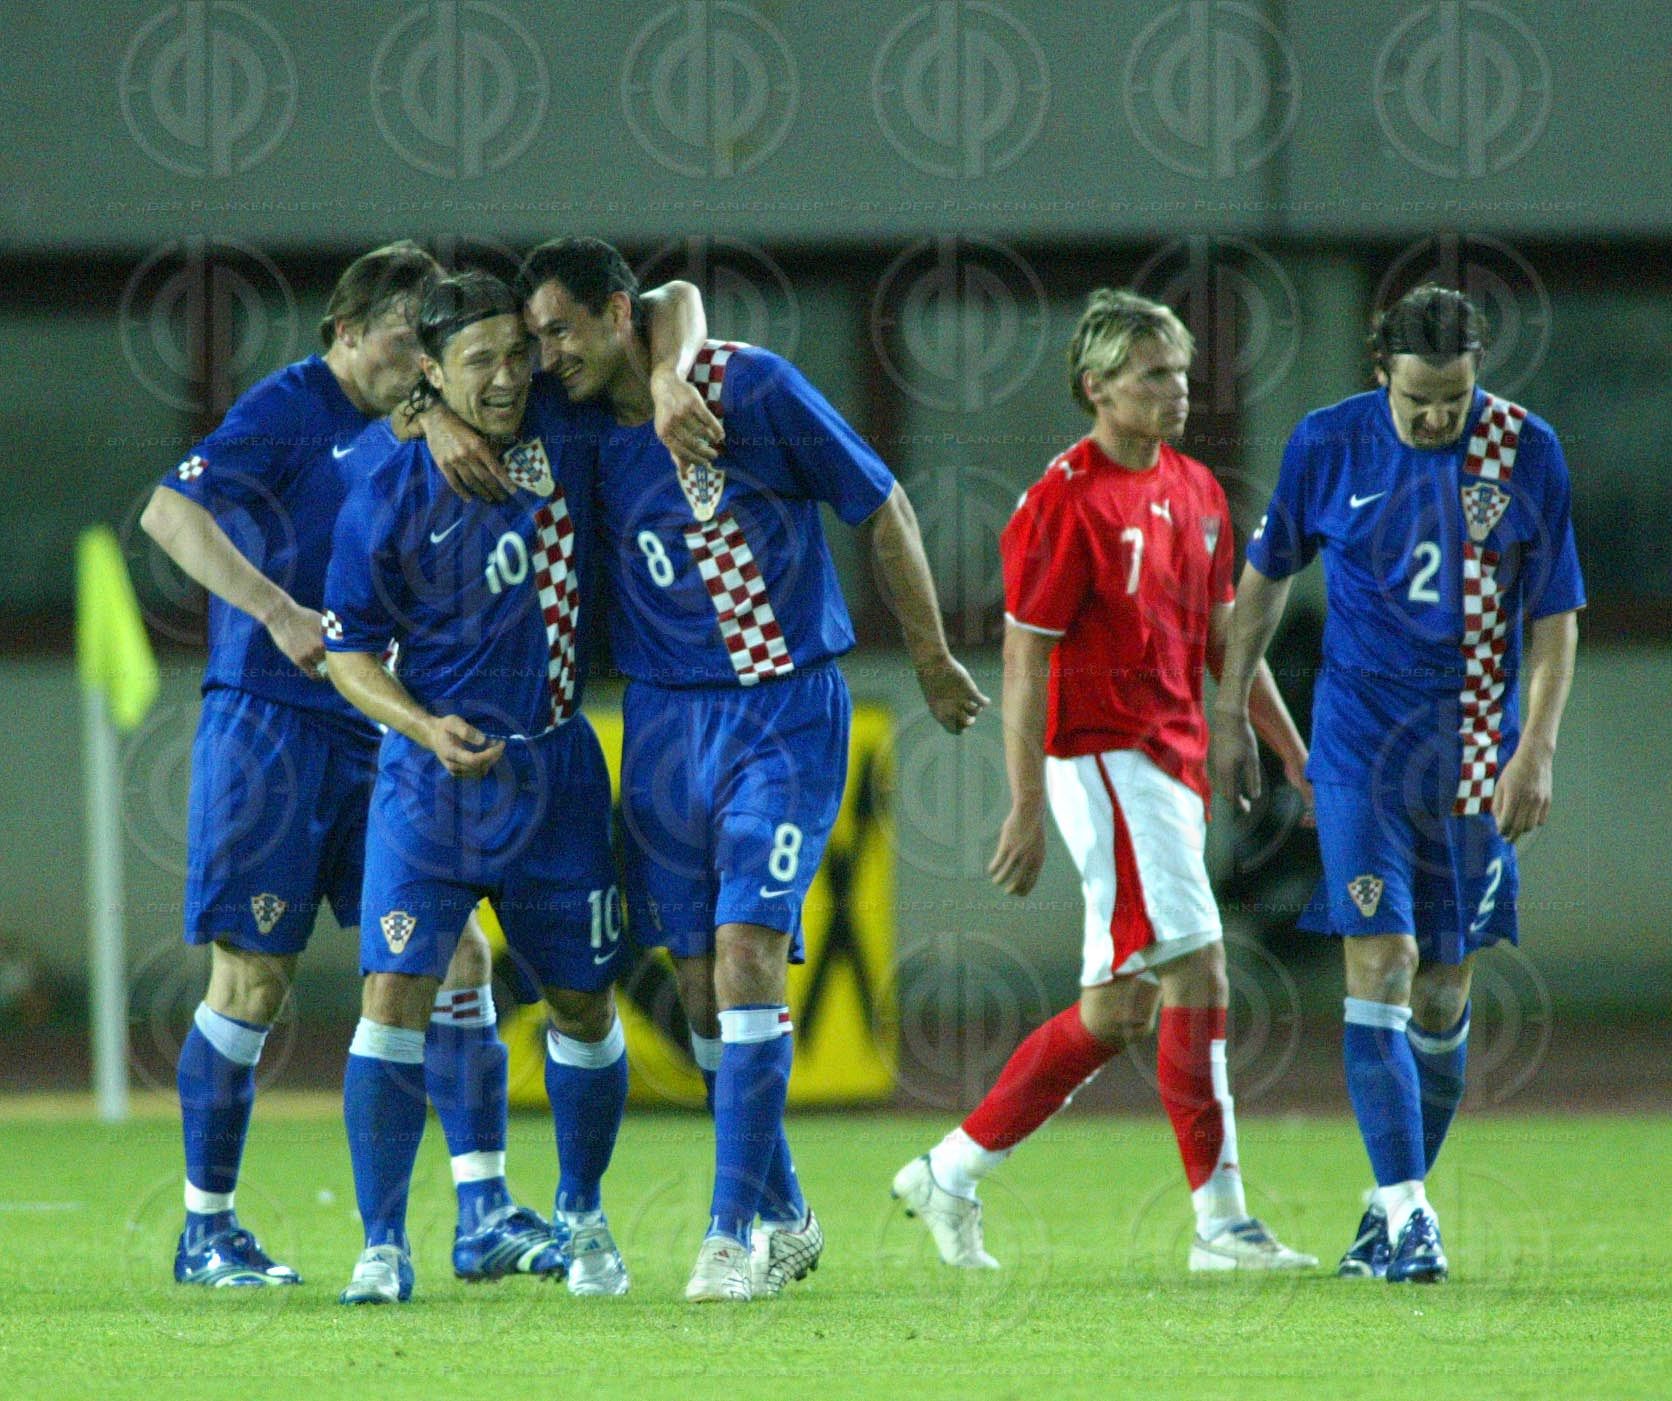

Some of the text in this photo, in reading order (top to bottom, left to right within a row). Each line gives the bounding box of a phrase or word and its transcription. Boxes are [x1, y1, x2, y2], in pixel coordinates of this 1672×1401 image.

[486, 531, 528, 594] 10
[637, 531, 675, 587] 8
[1121, 527, 1145, 595] 7
[1408, 541, 1442, 602] 2
[768, 822, 803, 882] 8
[587, 884, 621, 948] 10
[1477, 857, 1502, 914] 2
